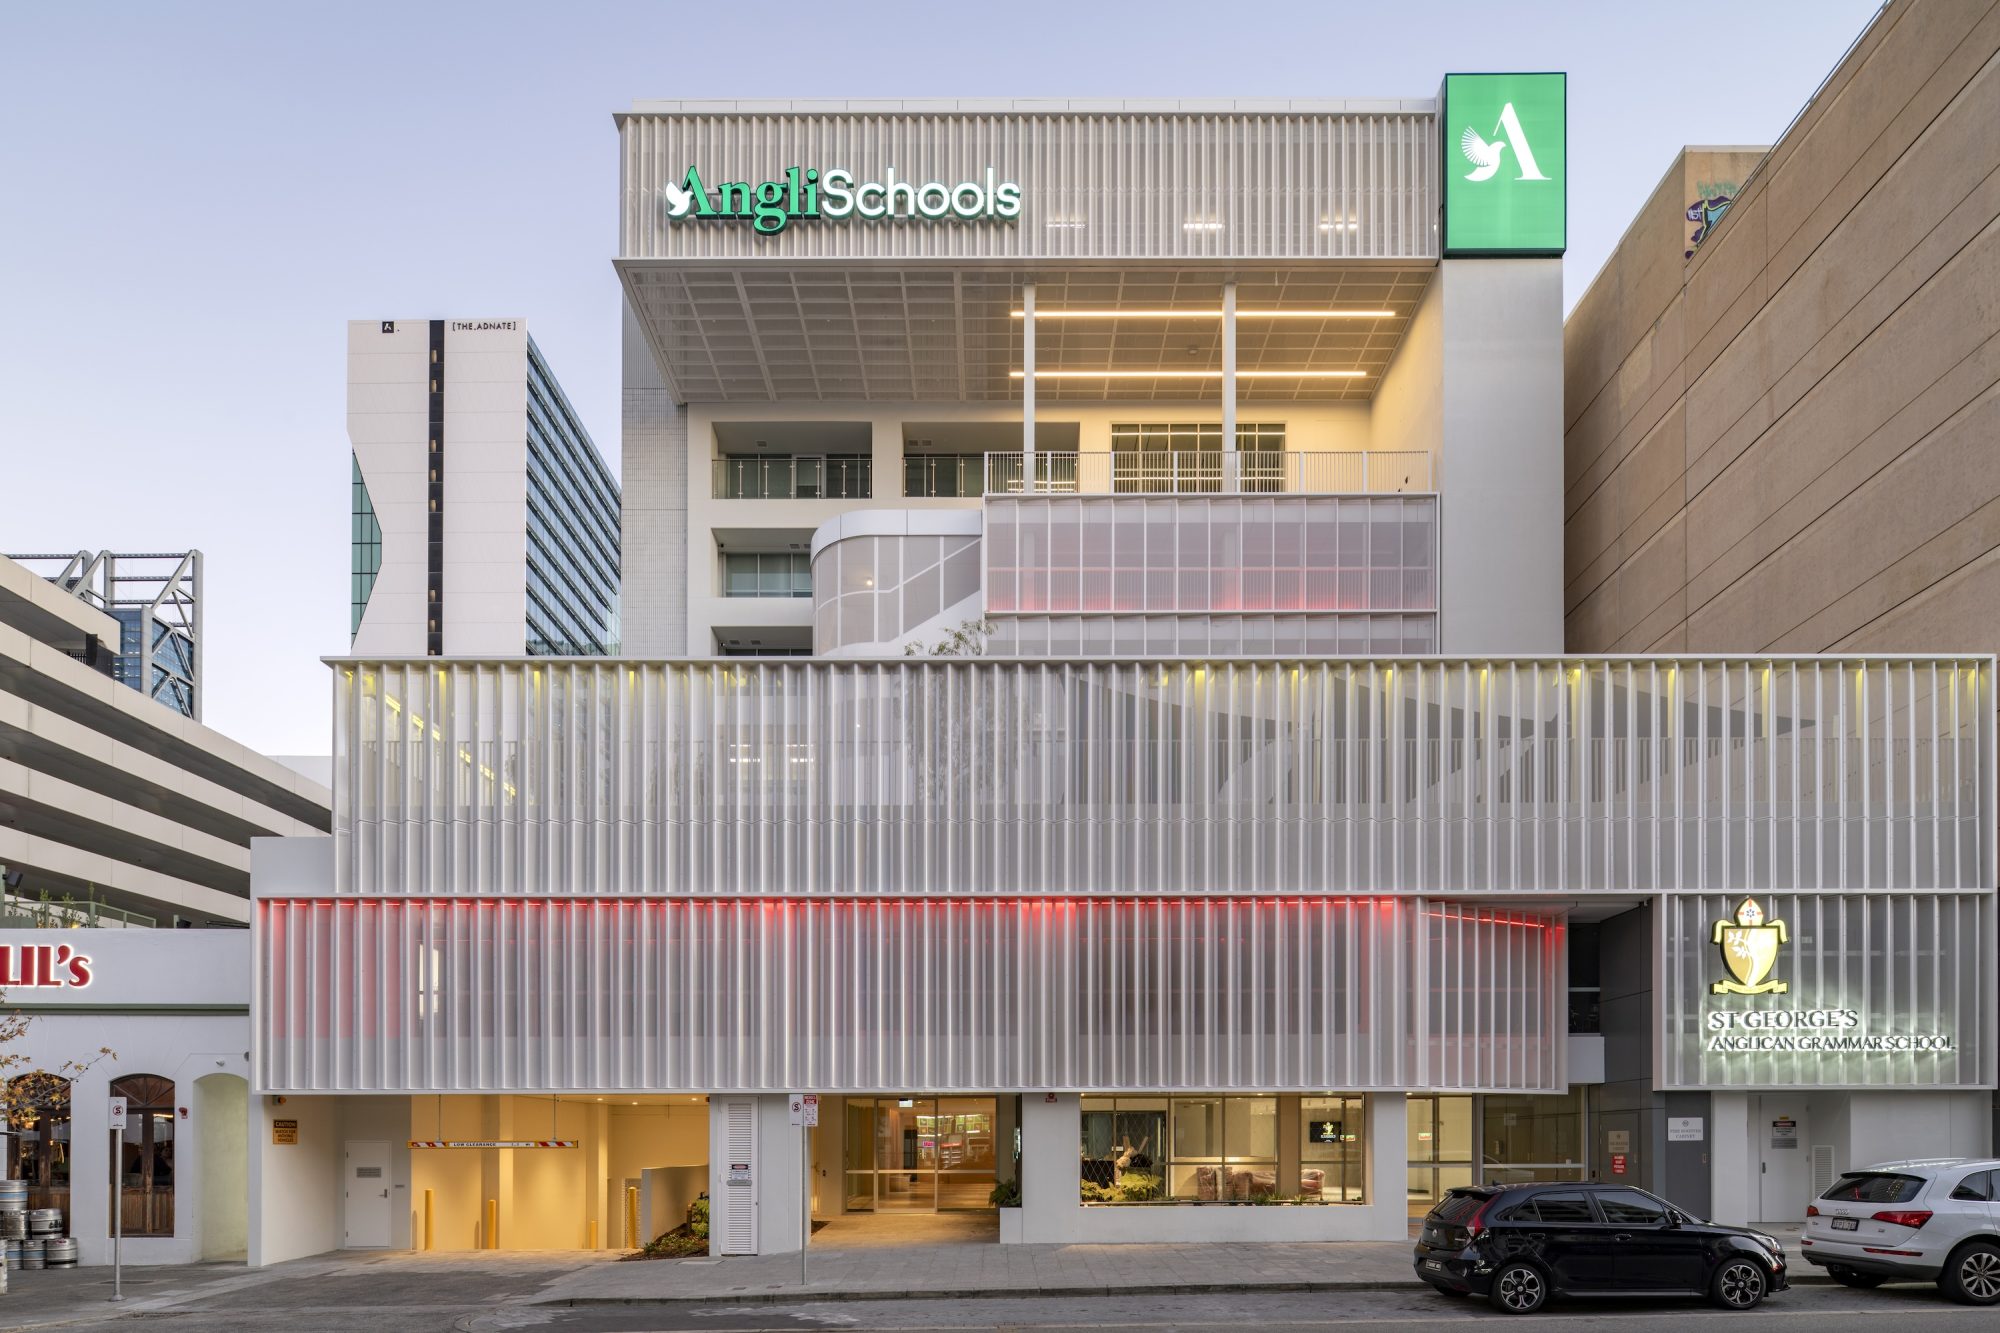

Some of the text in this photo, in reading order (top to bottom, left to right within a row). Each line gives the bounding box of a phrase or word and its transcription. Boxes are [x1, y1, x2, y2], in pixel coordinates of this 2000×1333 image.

[680, 165, 1021, 236] AngliSchools
[0, 945, 91, 987] LIL's
[1711, 1010, 1859, 1029] ST GEORGE'S
[1711, 1036, 1956, 1050] ANGLICAN GRAMMAR SCHOOL
